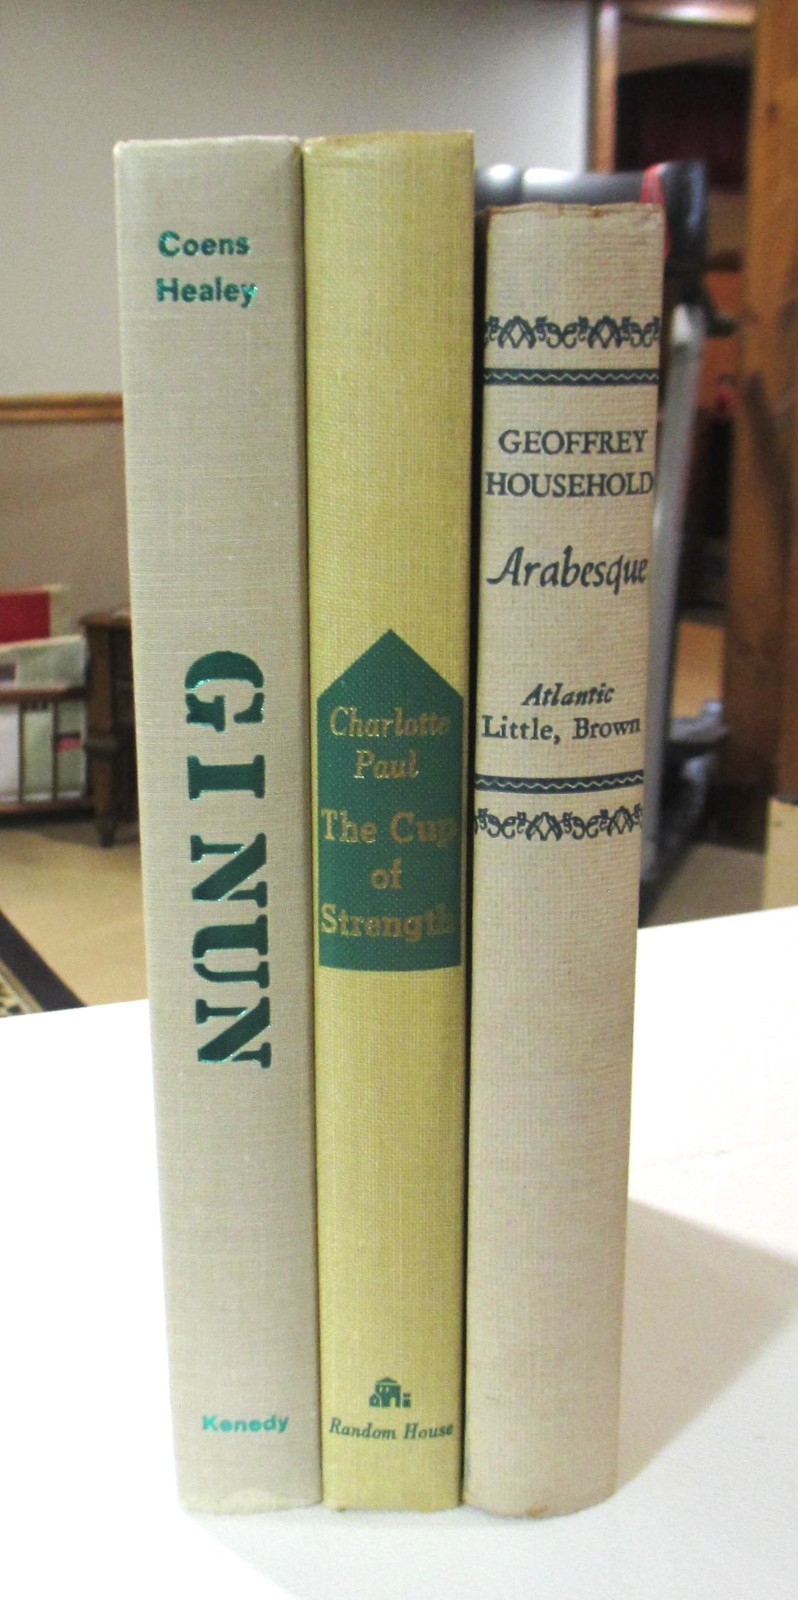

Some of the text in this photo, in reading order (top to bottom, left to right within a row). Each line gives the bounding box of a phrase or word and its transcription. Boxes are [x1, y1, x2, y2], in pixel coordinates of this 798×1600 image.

[158, 230, 250, 257] Coens
[156, 276, 258, 308] Healey
[498, 429, 648, 455] GEOFFREY
[485, 471, 655, 498] HOUSEHOLD
[486, 545, 648, 596] Arabesque
[520, 682, 615, 706] Atlantic
[329, 706, 450, 737] Charlotte
[481, 715, 640, 745] Little, Brown
[353, 750, 419, 779] Paul
[321, 809, 457, 848] The Cup
[370, 859, 402, 889] of
[320, 903, 456, 942] Strength
[202, 1415, 289, 1434] Kenedy
[329, 1417, 453, 1440] Random House
